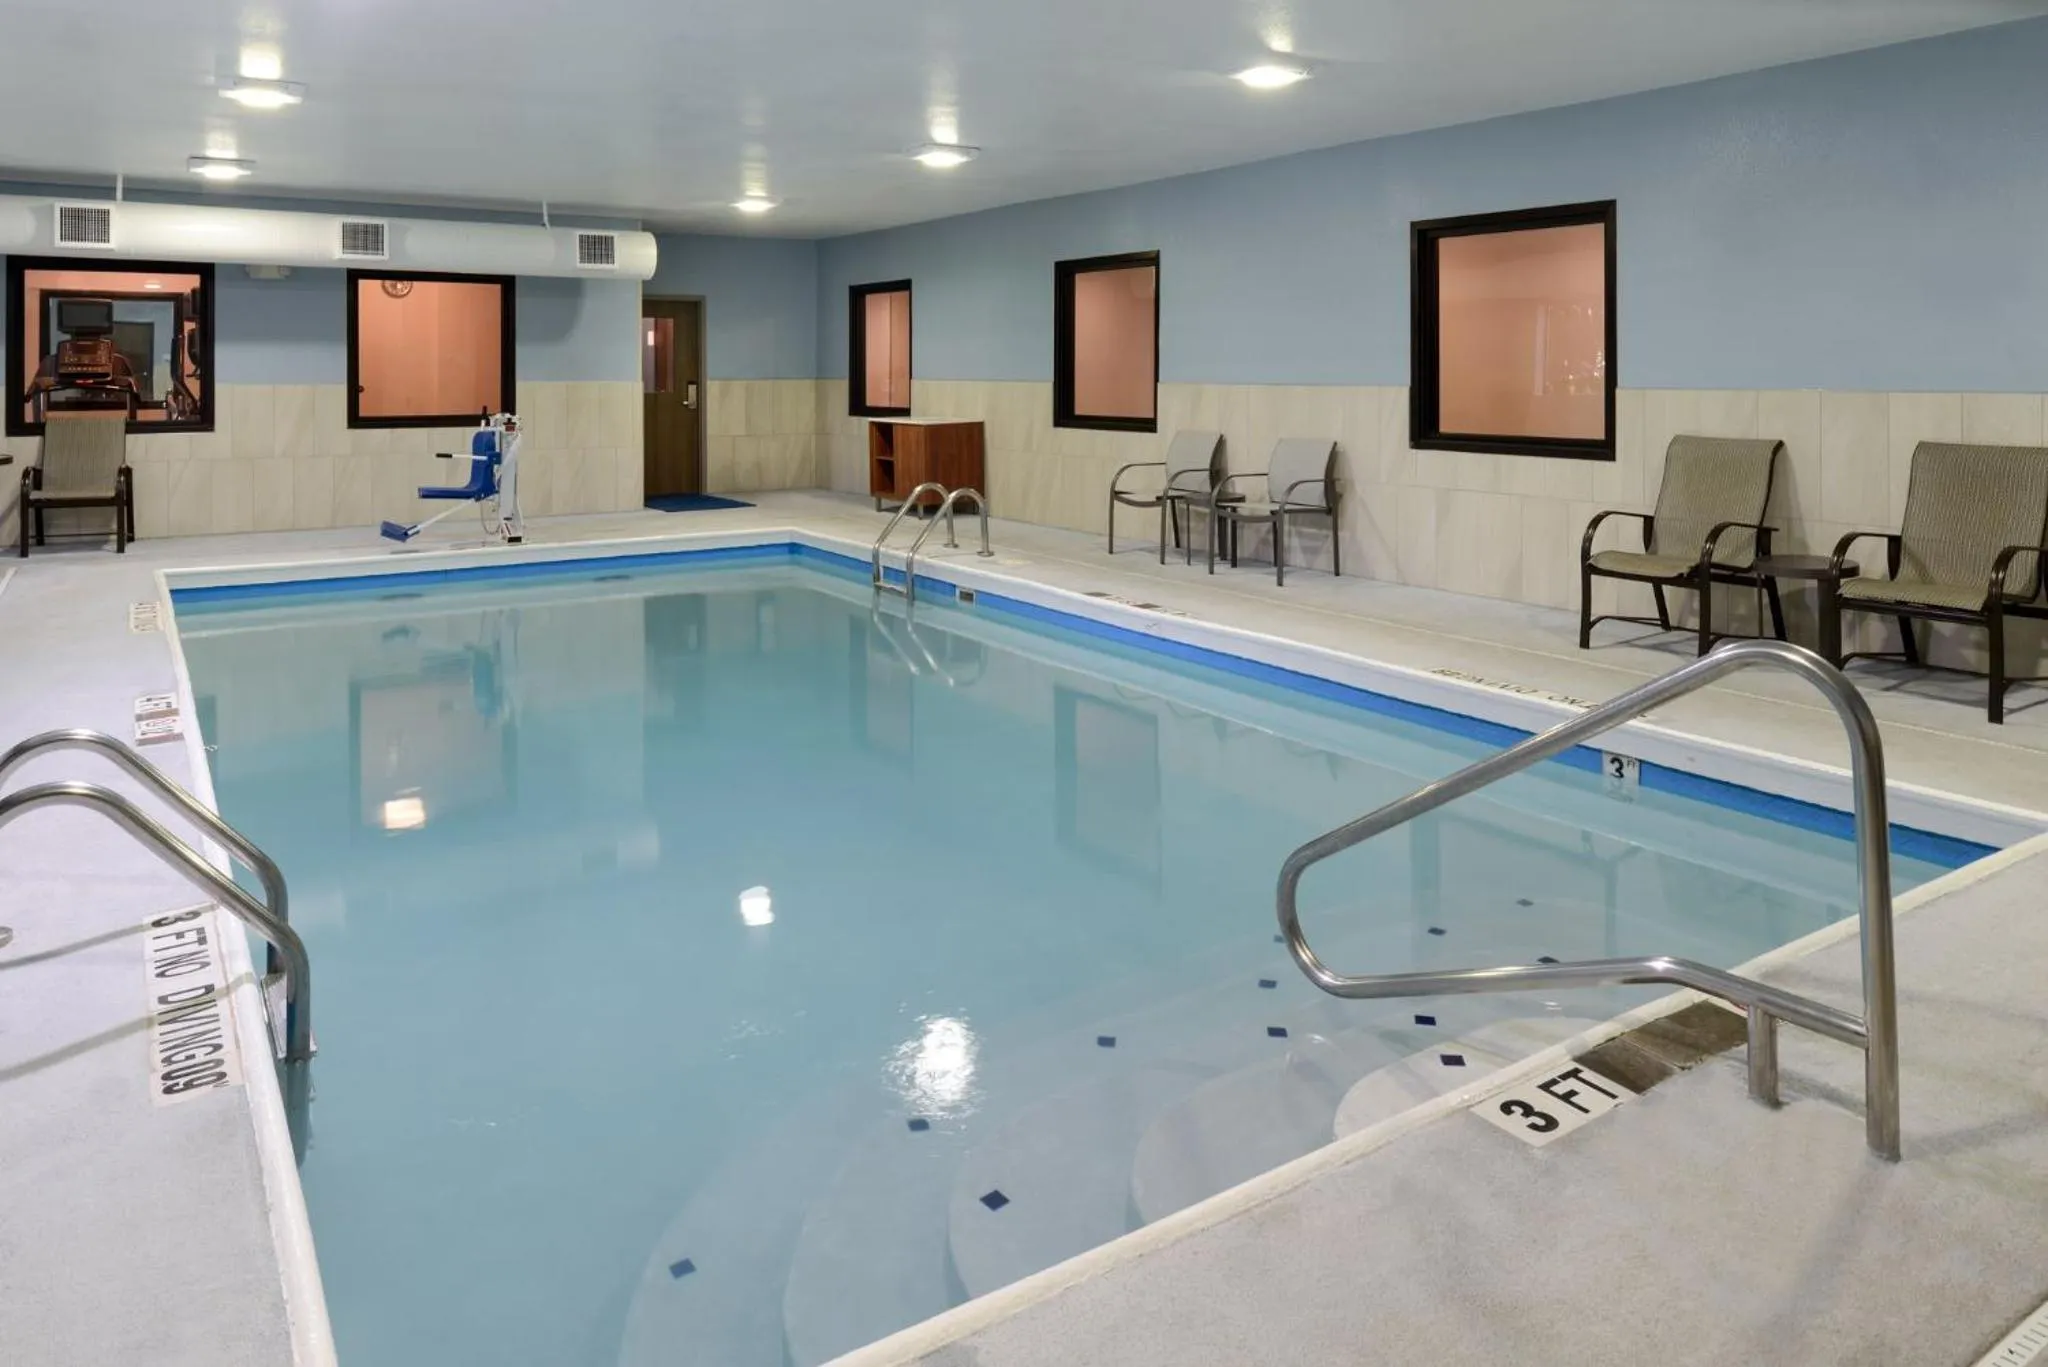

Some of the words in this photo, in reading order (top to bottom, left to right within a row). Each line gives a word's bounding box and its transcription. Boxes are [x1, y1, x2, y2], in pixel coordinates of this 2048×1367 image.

[1609, 756, 1624, 778] 3
[151, 911, 202, 927] 3
[152, 926, 208, 952] FT
[154, 949, 211, 978] NO
[157, 983, 224, 1067] DIVING
[1500, 1099, 1560, 1132] 3
[1537, 1067, 1619, 1113] FT
